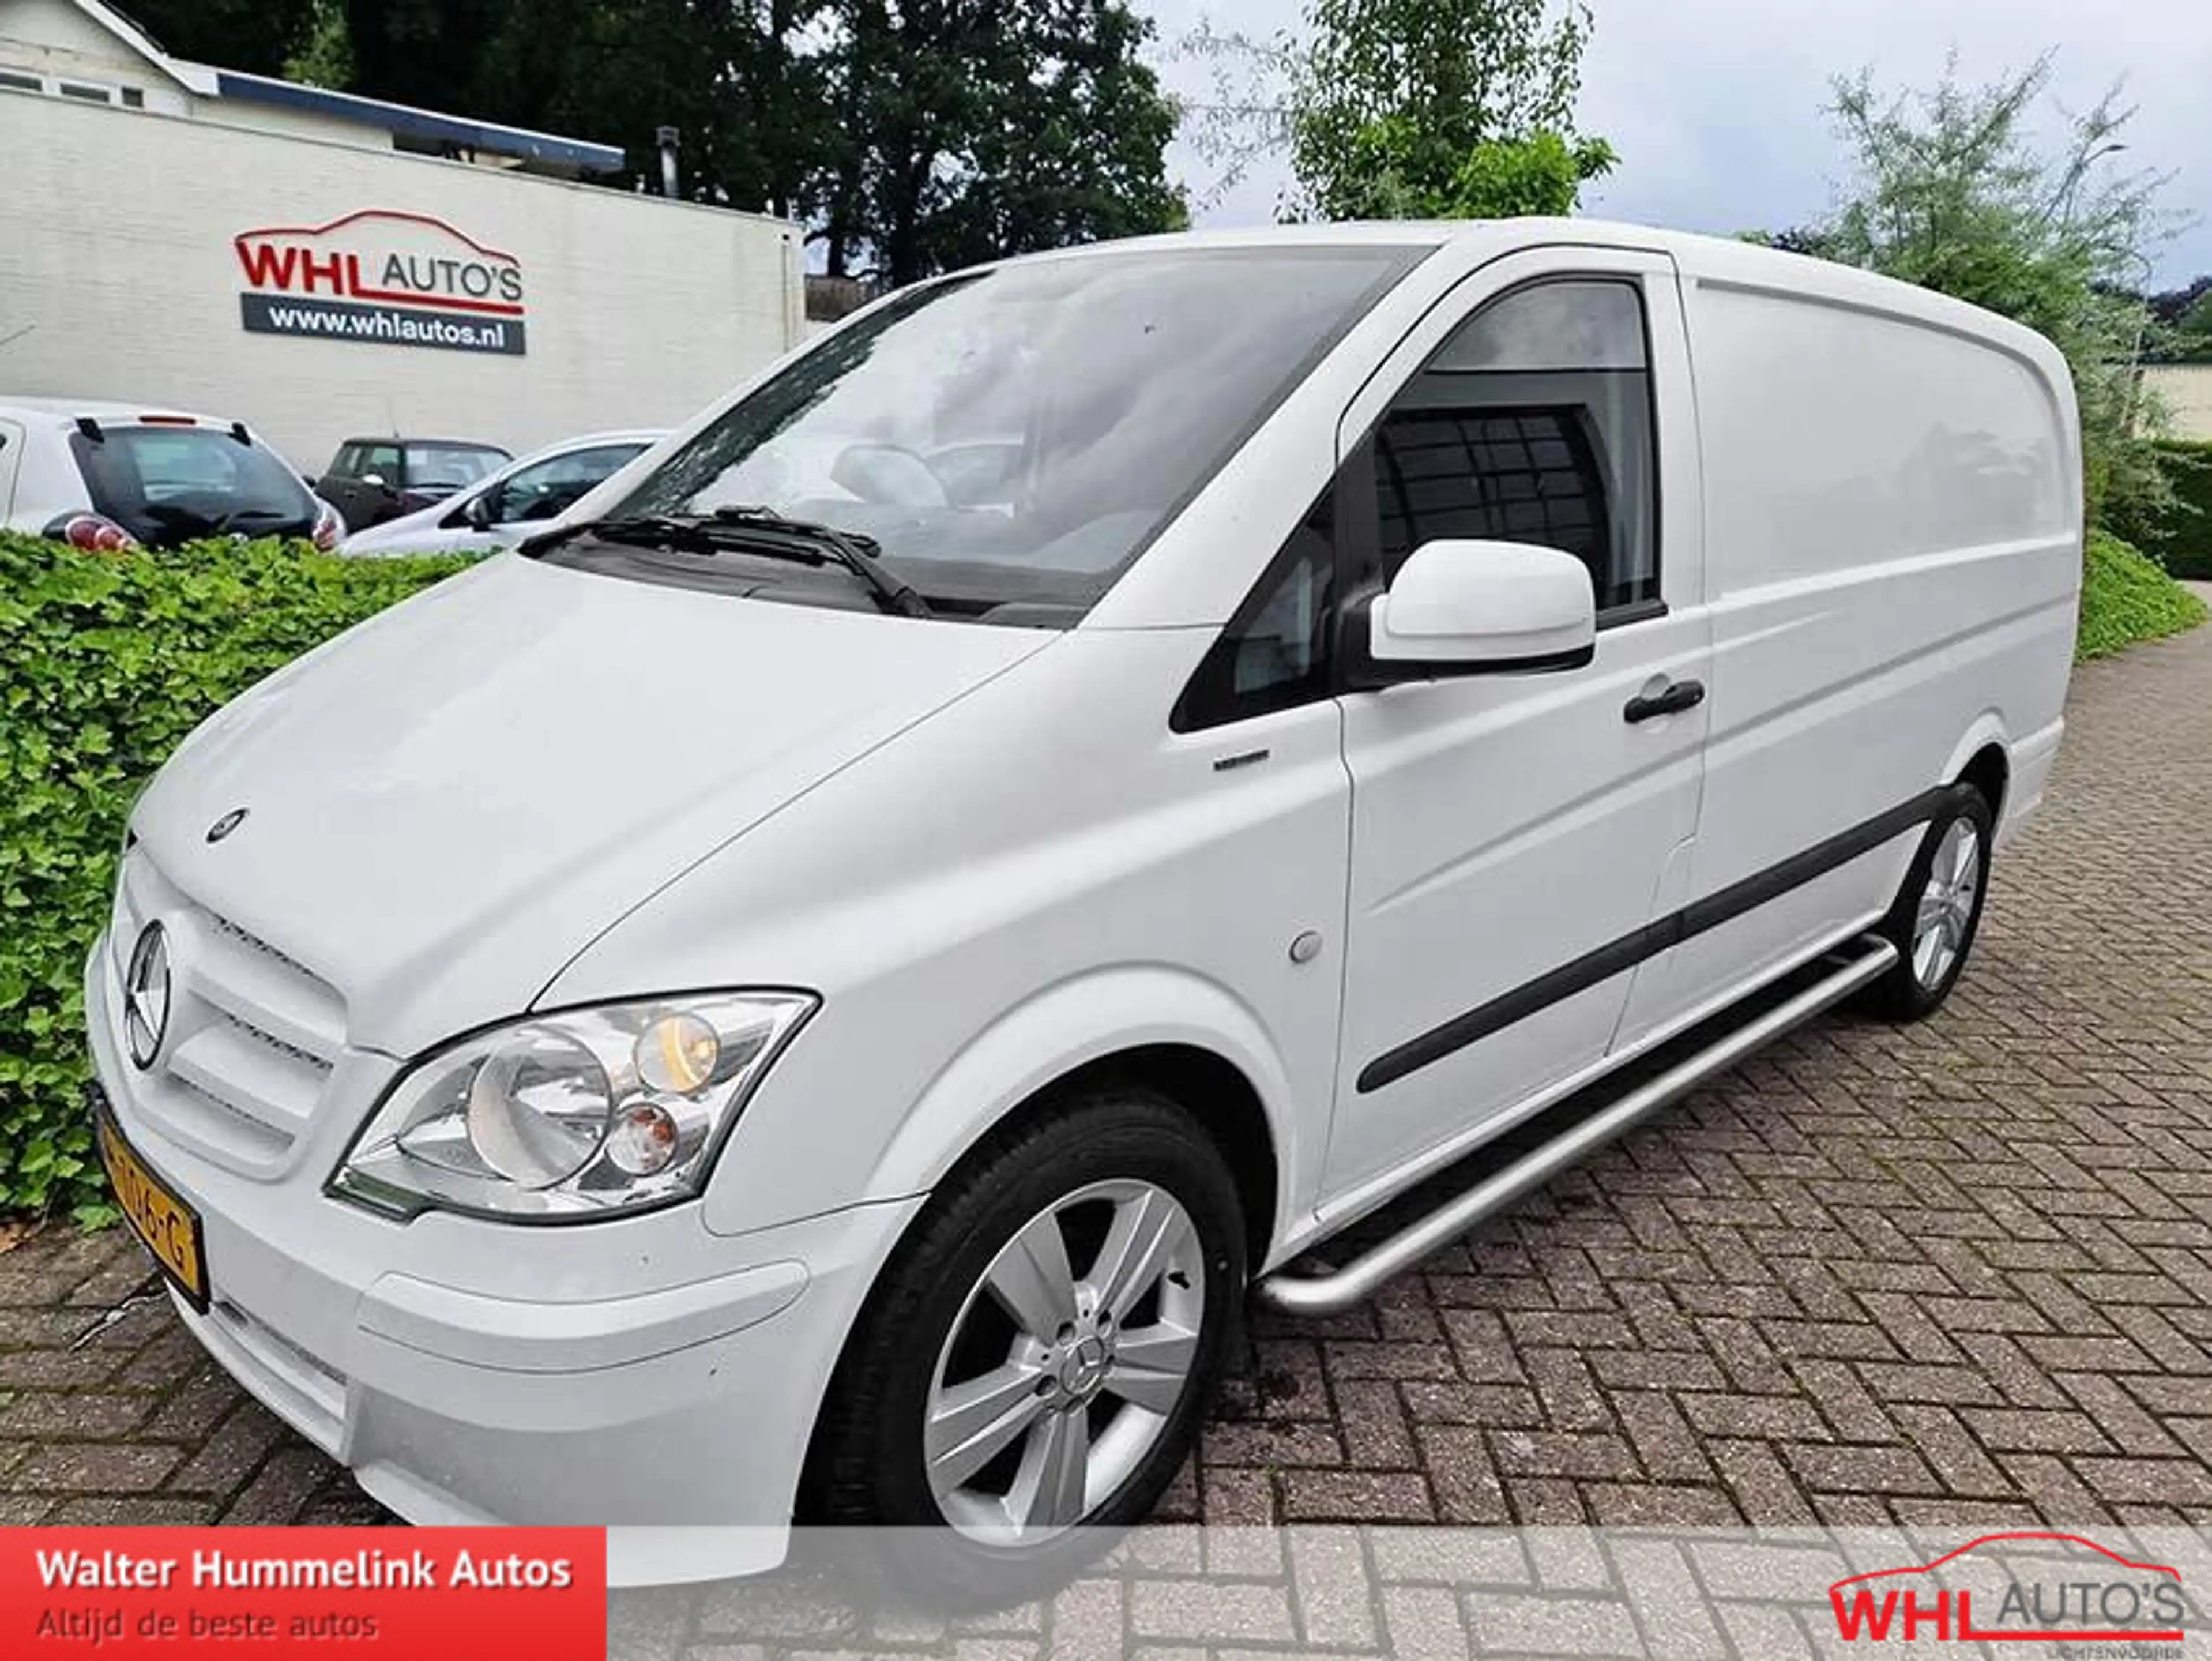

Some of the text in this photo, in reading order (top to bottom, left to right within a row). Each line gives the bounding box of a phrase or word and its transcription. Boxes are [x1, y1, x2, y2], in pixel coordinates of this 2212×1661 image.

[235, 240, 524, 302] WHL AUTO'S
[269, 307, 505, 347] www.whlautos.nl
